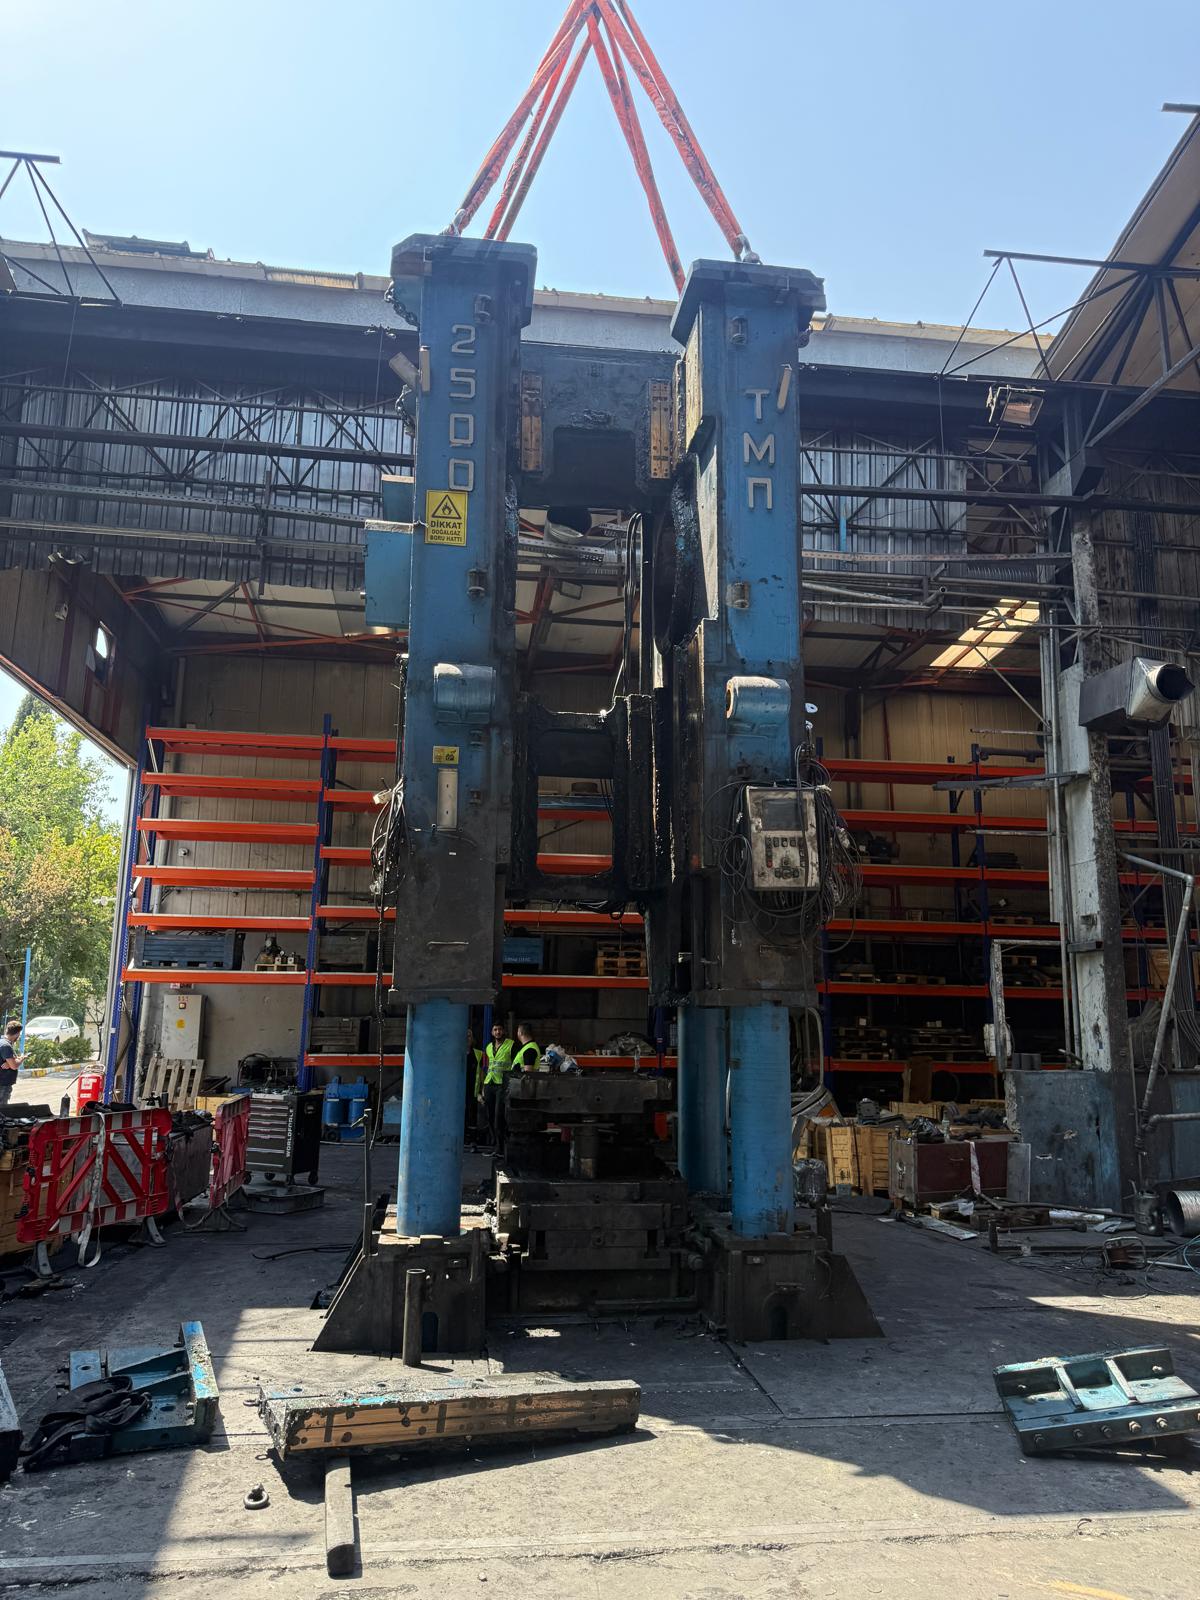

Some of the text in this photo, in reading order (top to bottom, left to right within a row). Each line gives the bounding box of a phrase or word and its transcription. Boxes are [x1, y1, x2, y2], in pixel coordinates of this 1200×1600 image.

[449, 324, 476, 492] 2500
[430, 520, 463, 529] DİKKAT
[431, 528, 461, 536] DOĞALGAZ
